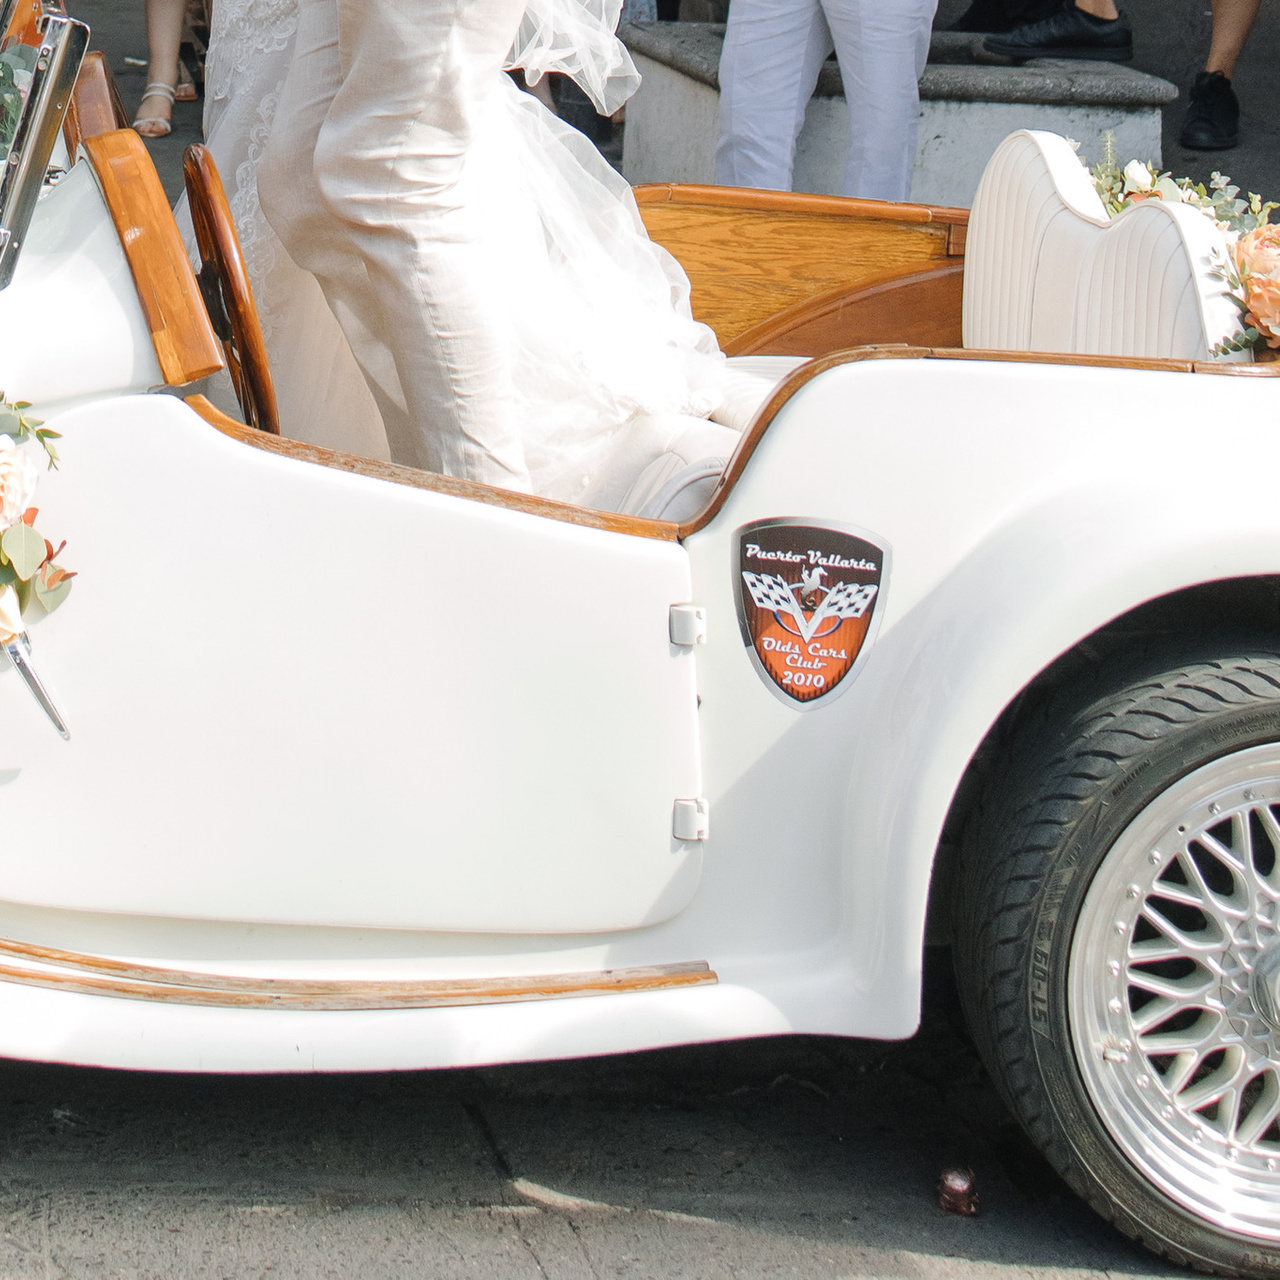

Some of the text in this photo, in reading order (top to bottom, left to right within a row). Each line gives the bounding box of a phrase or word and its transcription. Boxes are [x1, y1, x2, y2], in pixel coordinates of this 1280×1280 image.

[746, 544, 877, 571] Puerto Vallarta
[762, 637, 848, 659] Olds Cars
[785, 653, 827, 669] Club
[782, 671, 825, 688] 2010
